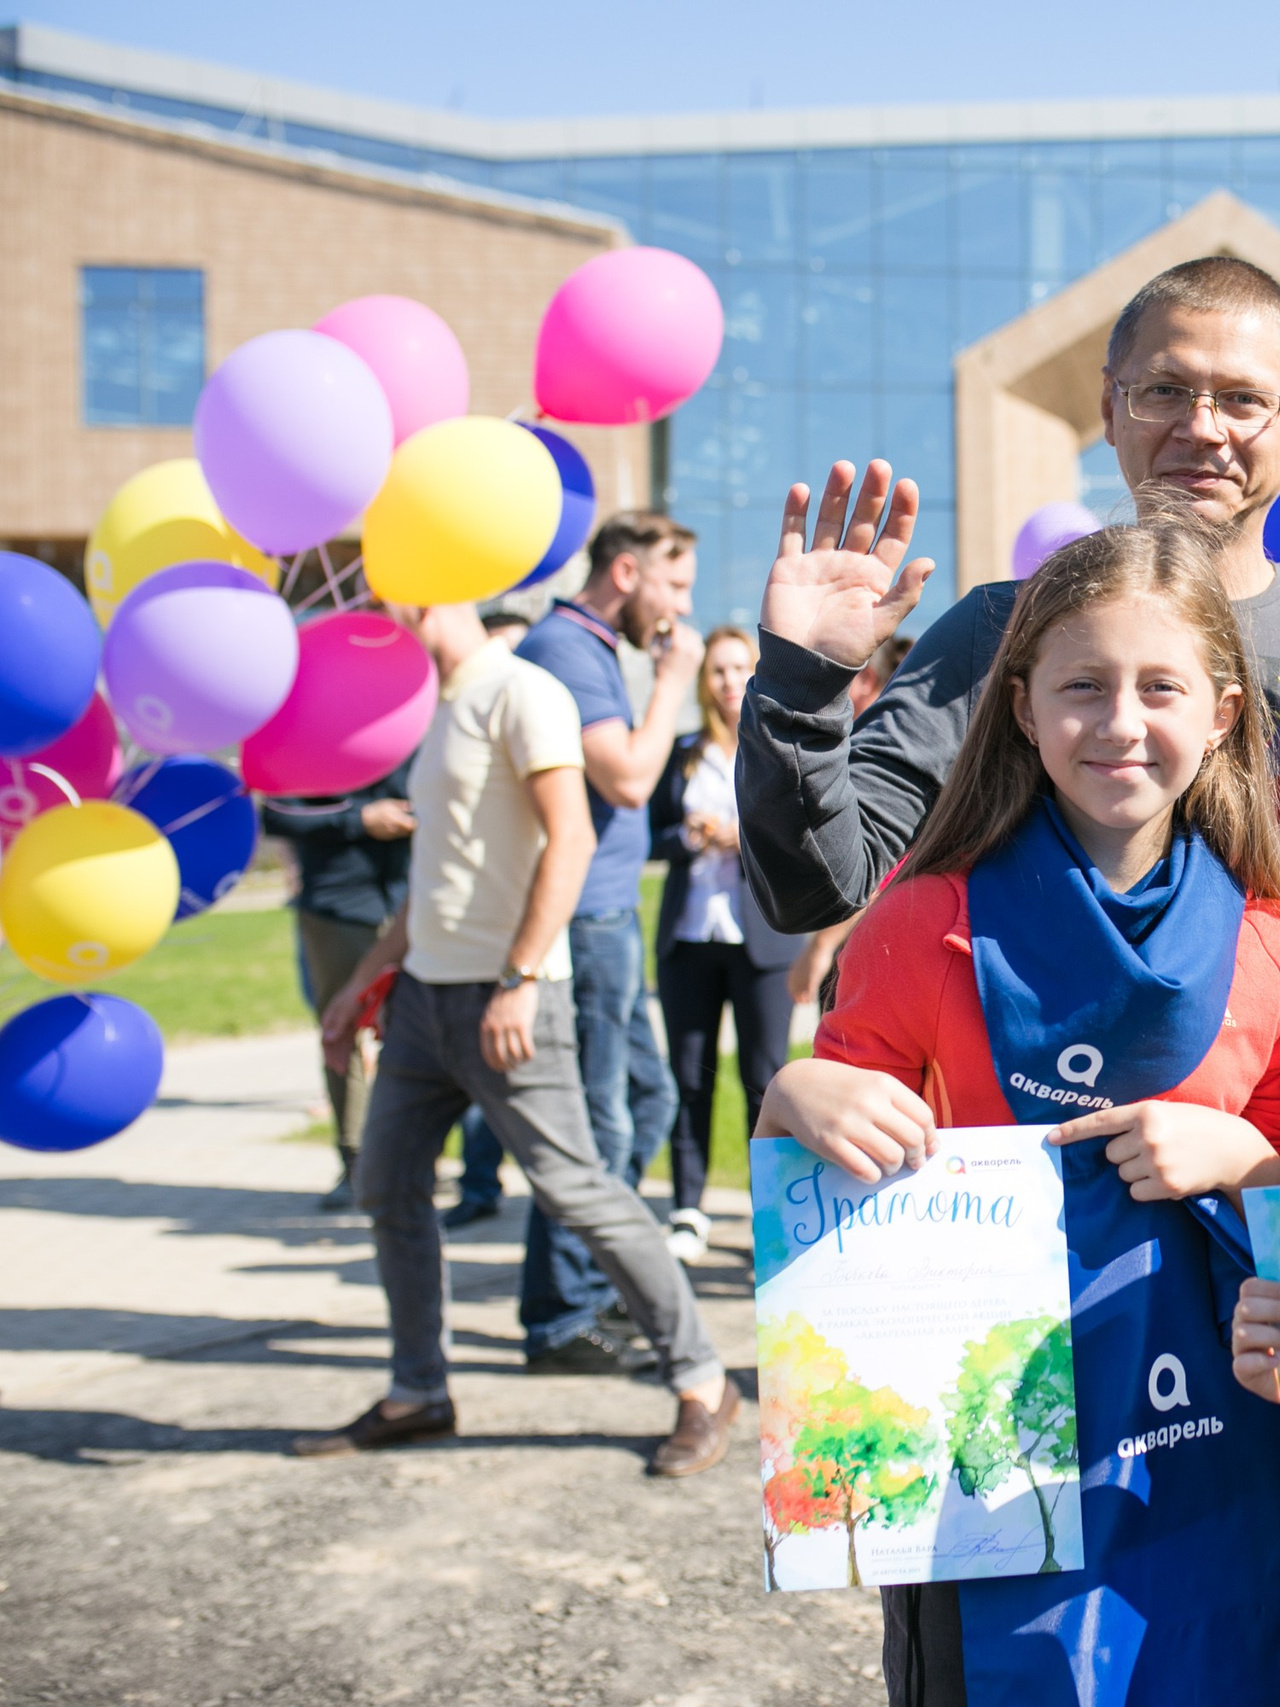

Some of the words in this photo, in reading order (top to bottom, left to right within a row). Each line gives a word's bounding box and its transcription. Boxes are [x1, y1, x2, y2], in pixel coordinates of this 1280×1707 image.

[1009, 1072, 1114, 1109] акварель
[970, 1157, 1022, 1169] акварель
[785, 1161, 1024, 1254] Грамота
[1117, 1416, 1224, 1458] акварель
